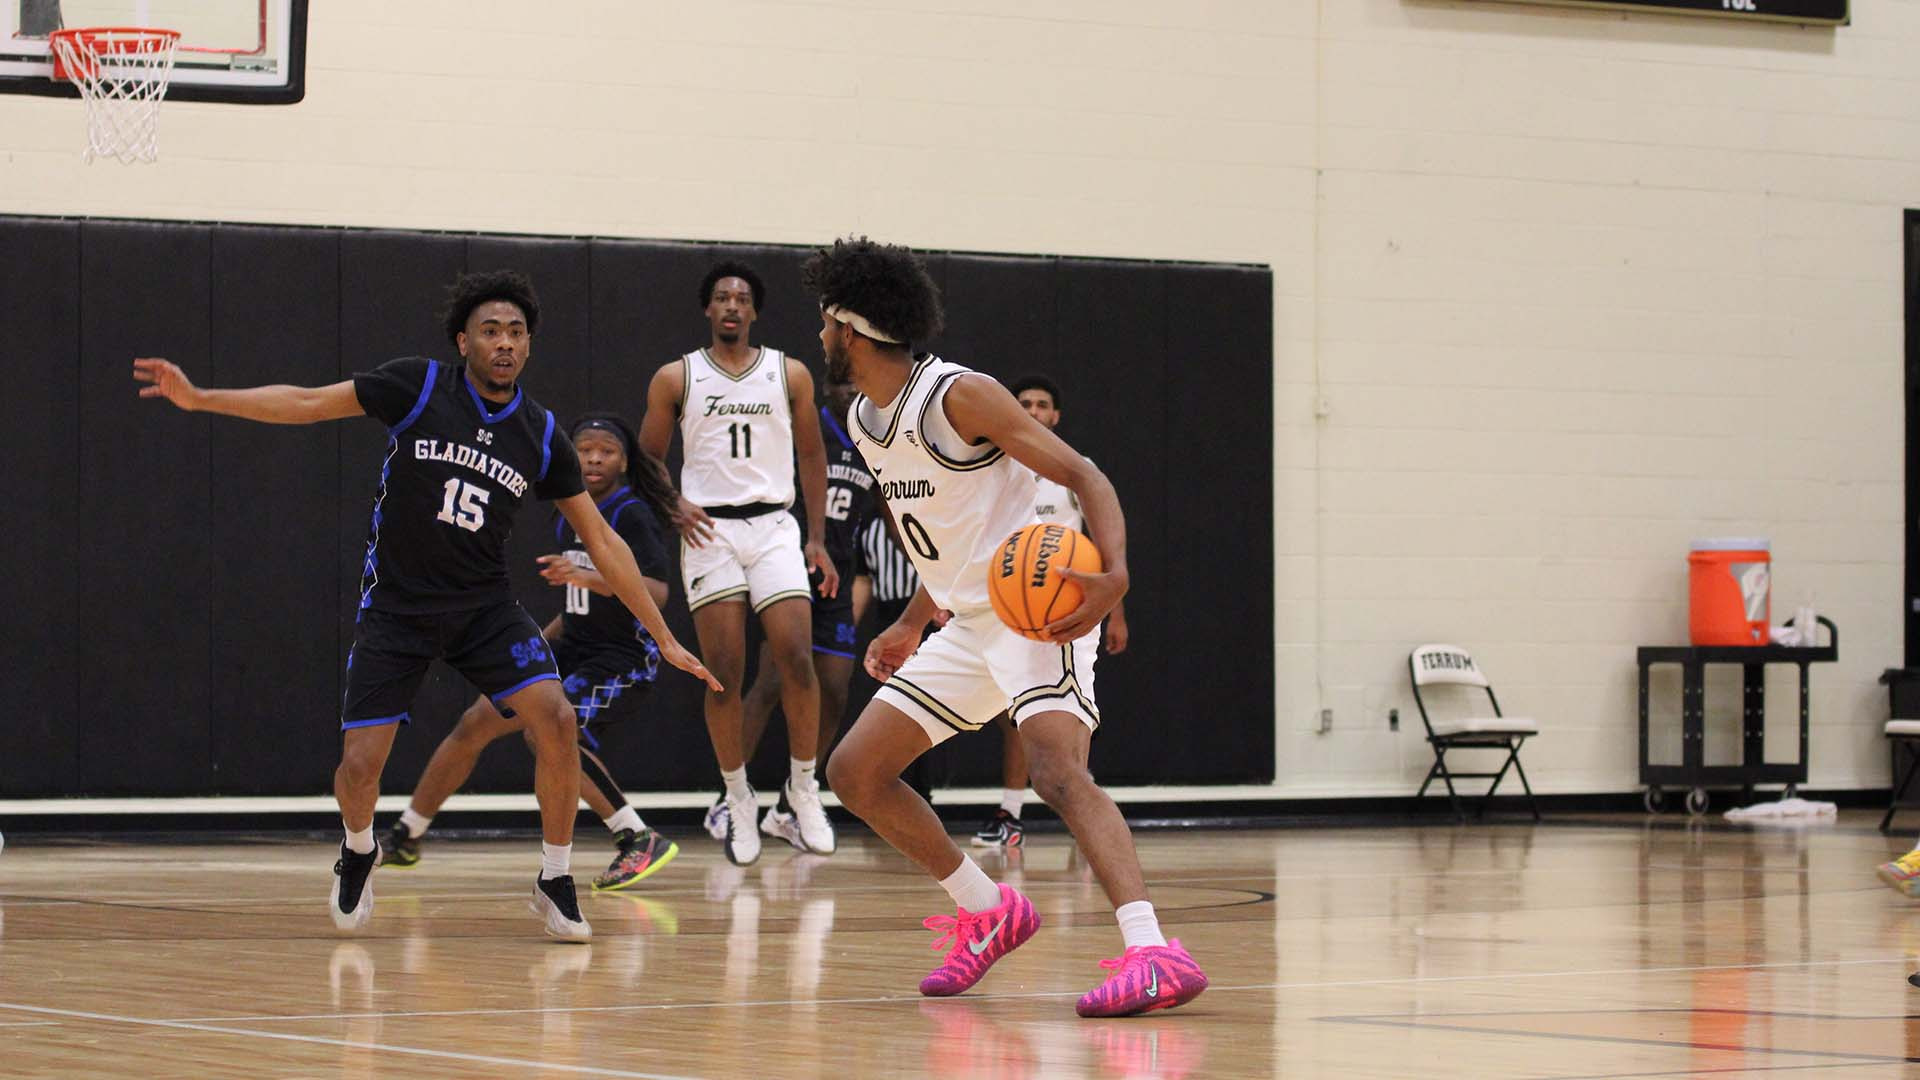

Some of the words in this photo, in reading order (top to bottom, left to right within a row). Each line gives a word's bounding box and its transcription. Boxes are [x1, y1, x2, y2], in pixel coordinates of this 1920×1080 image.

[703, 394, 772, 417] Ferrum
[728, 422, 751, 458] 11
[415, 439, 528, 498] GLADIATORS
[872, 466, 936, 501] errum
[436, 477, 490, 532] 15
[825, 486, 853, 521] 12
[901, 513, 939, 561] 0
[1031, 525, 1066, 588] Wilson
[565, 580, 590, 616] 10
[1421, 652, 1475, 672] FERRUM
